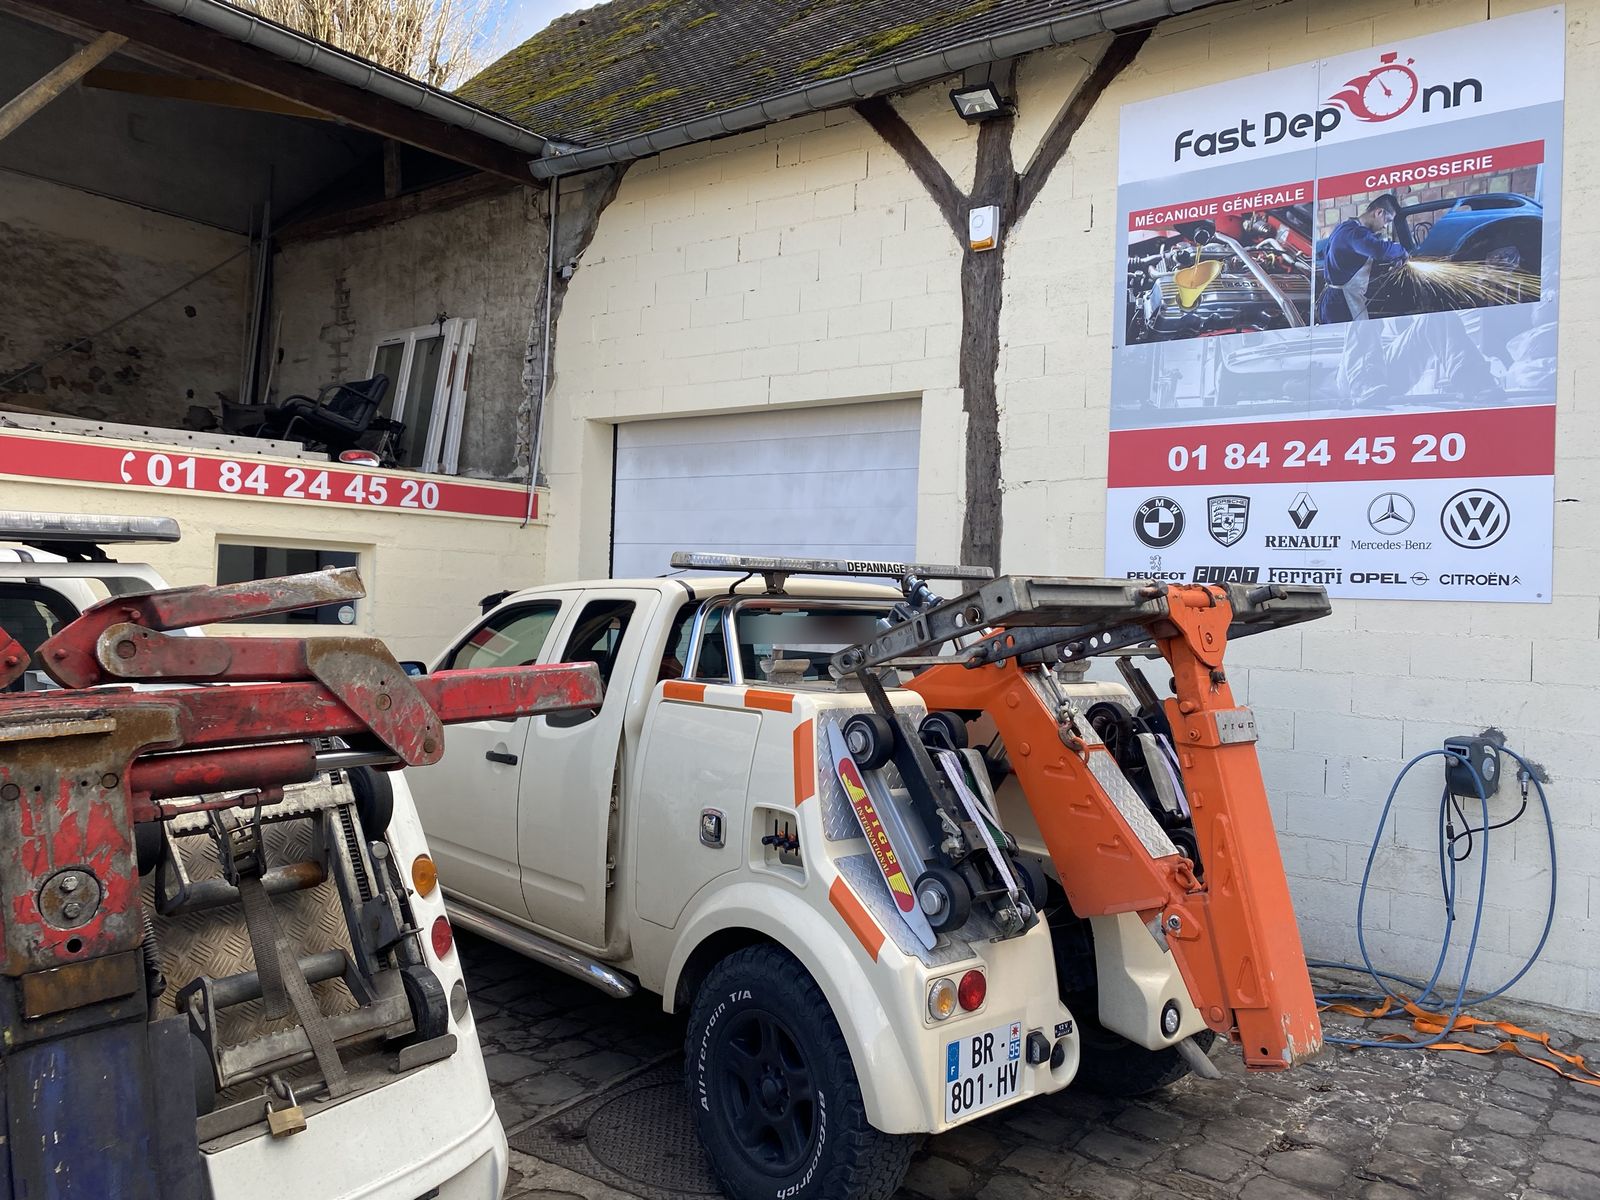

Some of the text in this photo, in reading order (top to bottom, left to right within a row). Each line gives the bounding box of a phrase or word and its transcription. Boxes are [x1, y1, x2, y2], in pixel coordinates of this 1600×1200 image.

[1174, 119, 1256, 162] Fast
[1364, 155, 1494, 190] CARROSSERIE
[1134, 187, 1305, 229] MÉCANIQUE GÉNÉRALE
[1167, 432, 1467, 473] 01 84 24 45 20
[146, 453, 439, 510] 01 84 24 45 20
[1139, 499, 1180, 515] BMW
[1265, 535, 1341, 549] RENAULT
[1350, 539, 1432, 551] Mercedes-Benz
[847, 561, 906, 574] DEPANNAGE
[1126, 571, 1187, 581] PEUGEOT
[1193, 566, 1260, 583] FIAT
[1268, 567, 1343, 585] Ferrari
[1350, 572, 1407, 585] OPEL
[1439, 572, 1510, 586] CITROËN
[856, 806, 890, 874] INTERNATIONAL
[864, 804, 897, 865] JIGE
[1009, 1040, 1020, 1058] 95
